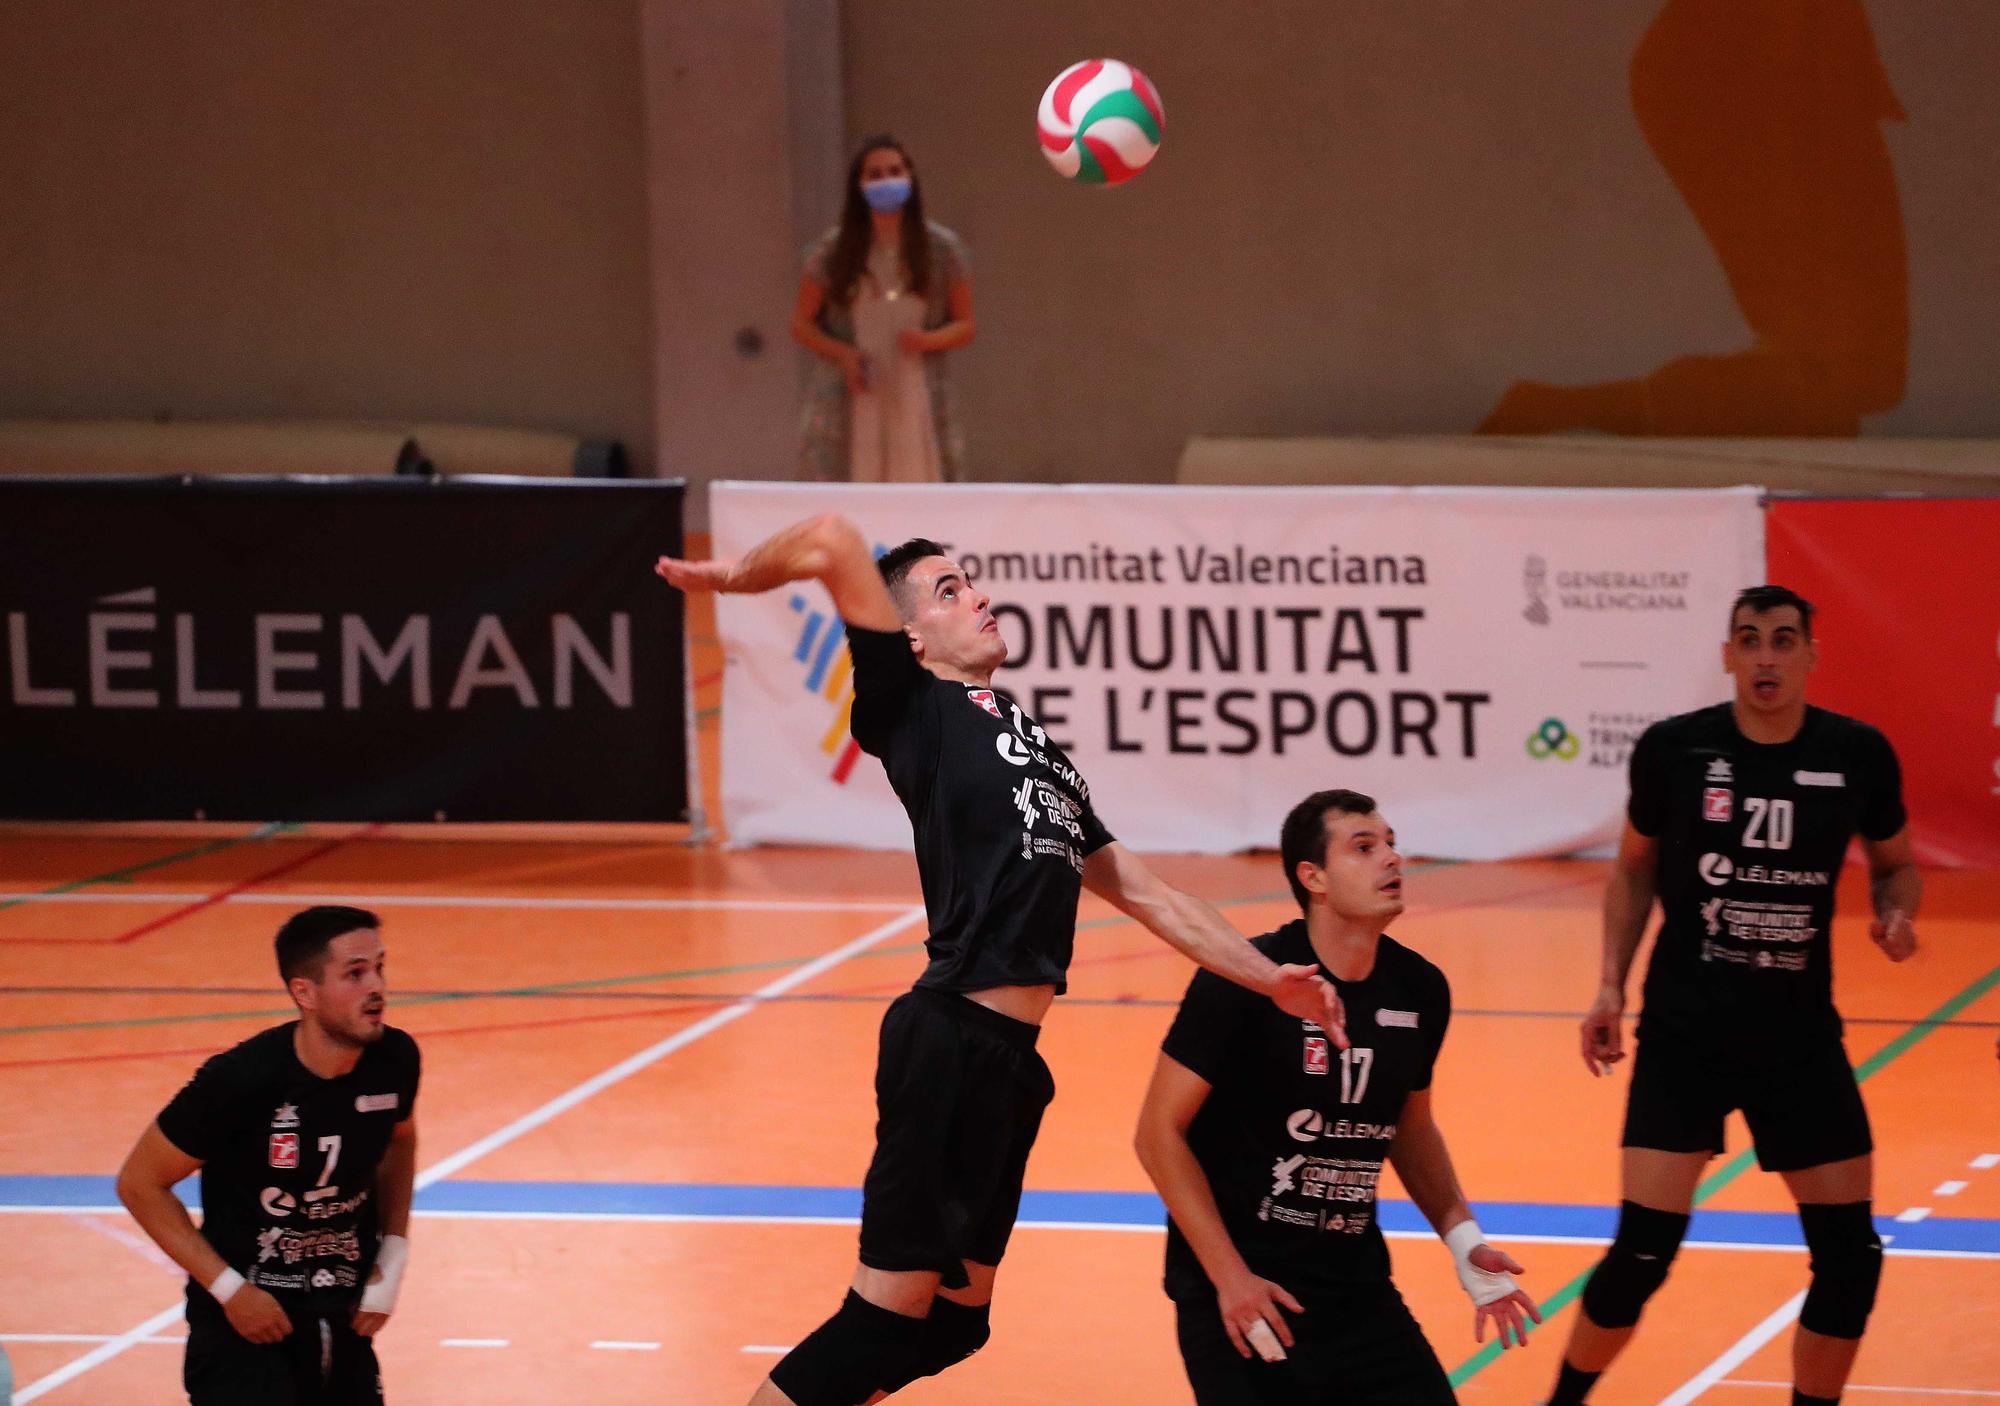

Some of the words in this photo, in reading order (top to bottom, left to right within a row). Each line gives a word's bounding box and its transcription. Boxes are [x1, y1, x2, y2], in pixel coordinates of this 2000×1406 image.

[941, 543, 1164, 583] omunitat
[1176, 544, 1427, 585] Valenciana
[1556, 571, 1690, 589] GENERALITAT
[1558, 594, 1687, 611] VALENCIANA
[8, 587, 634, 710] LÉLEMAN
[990, 604, 1424, 674] OMUNITAT
[1742, 797, 1794, 850] 20
[1339, 1047, 1374, 1104] 17
[317, 1134, 342, 1187] 7
